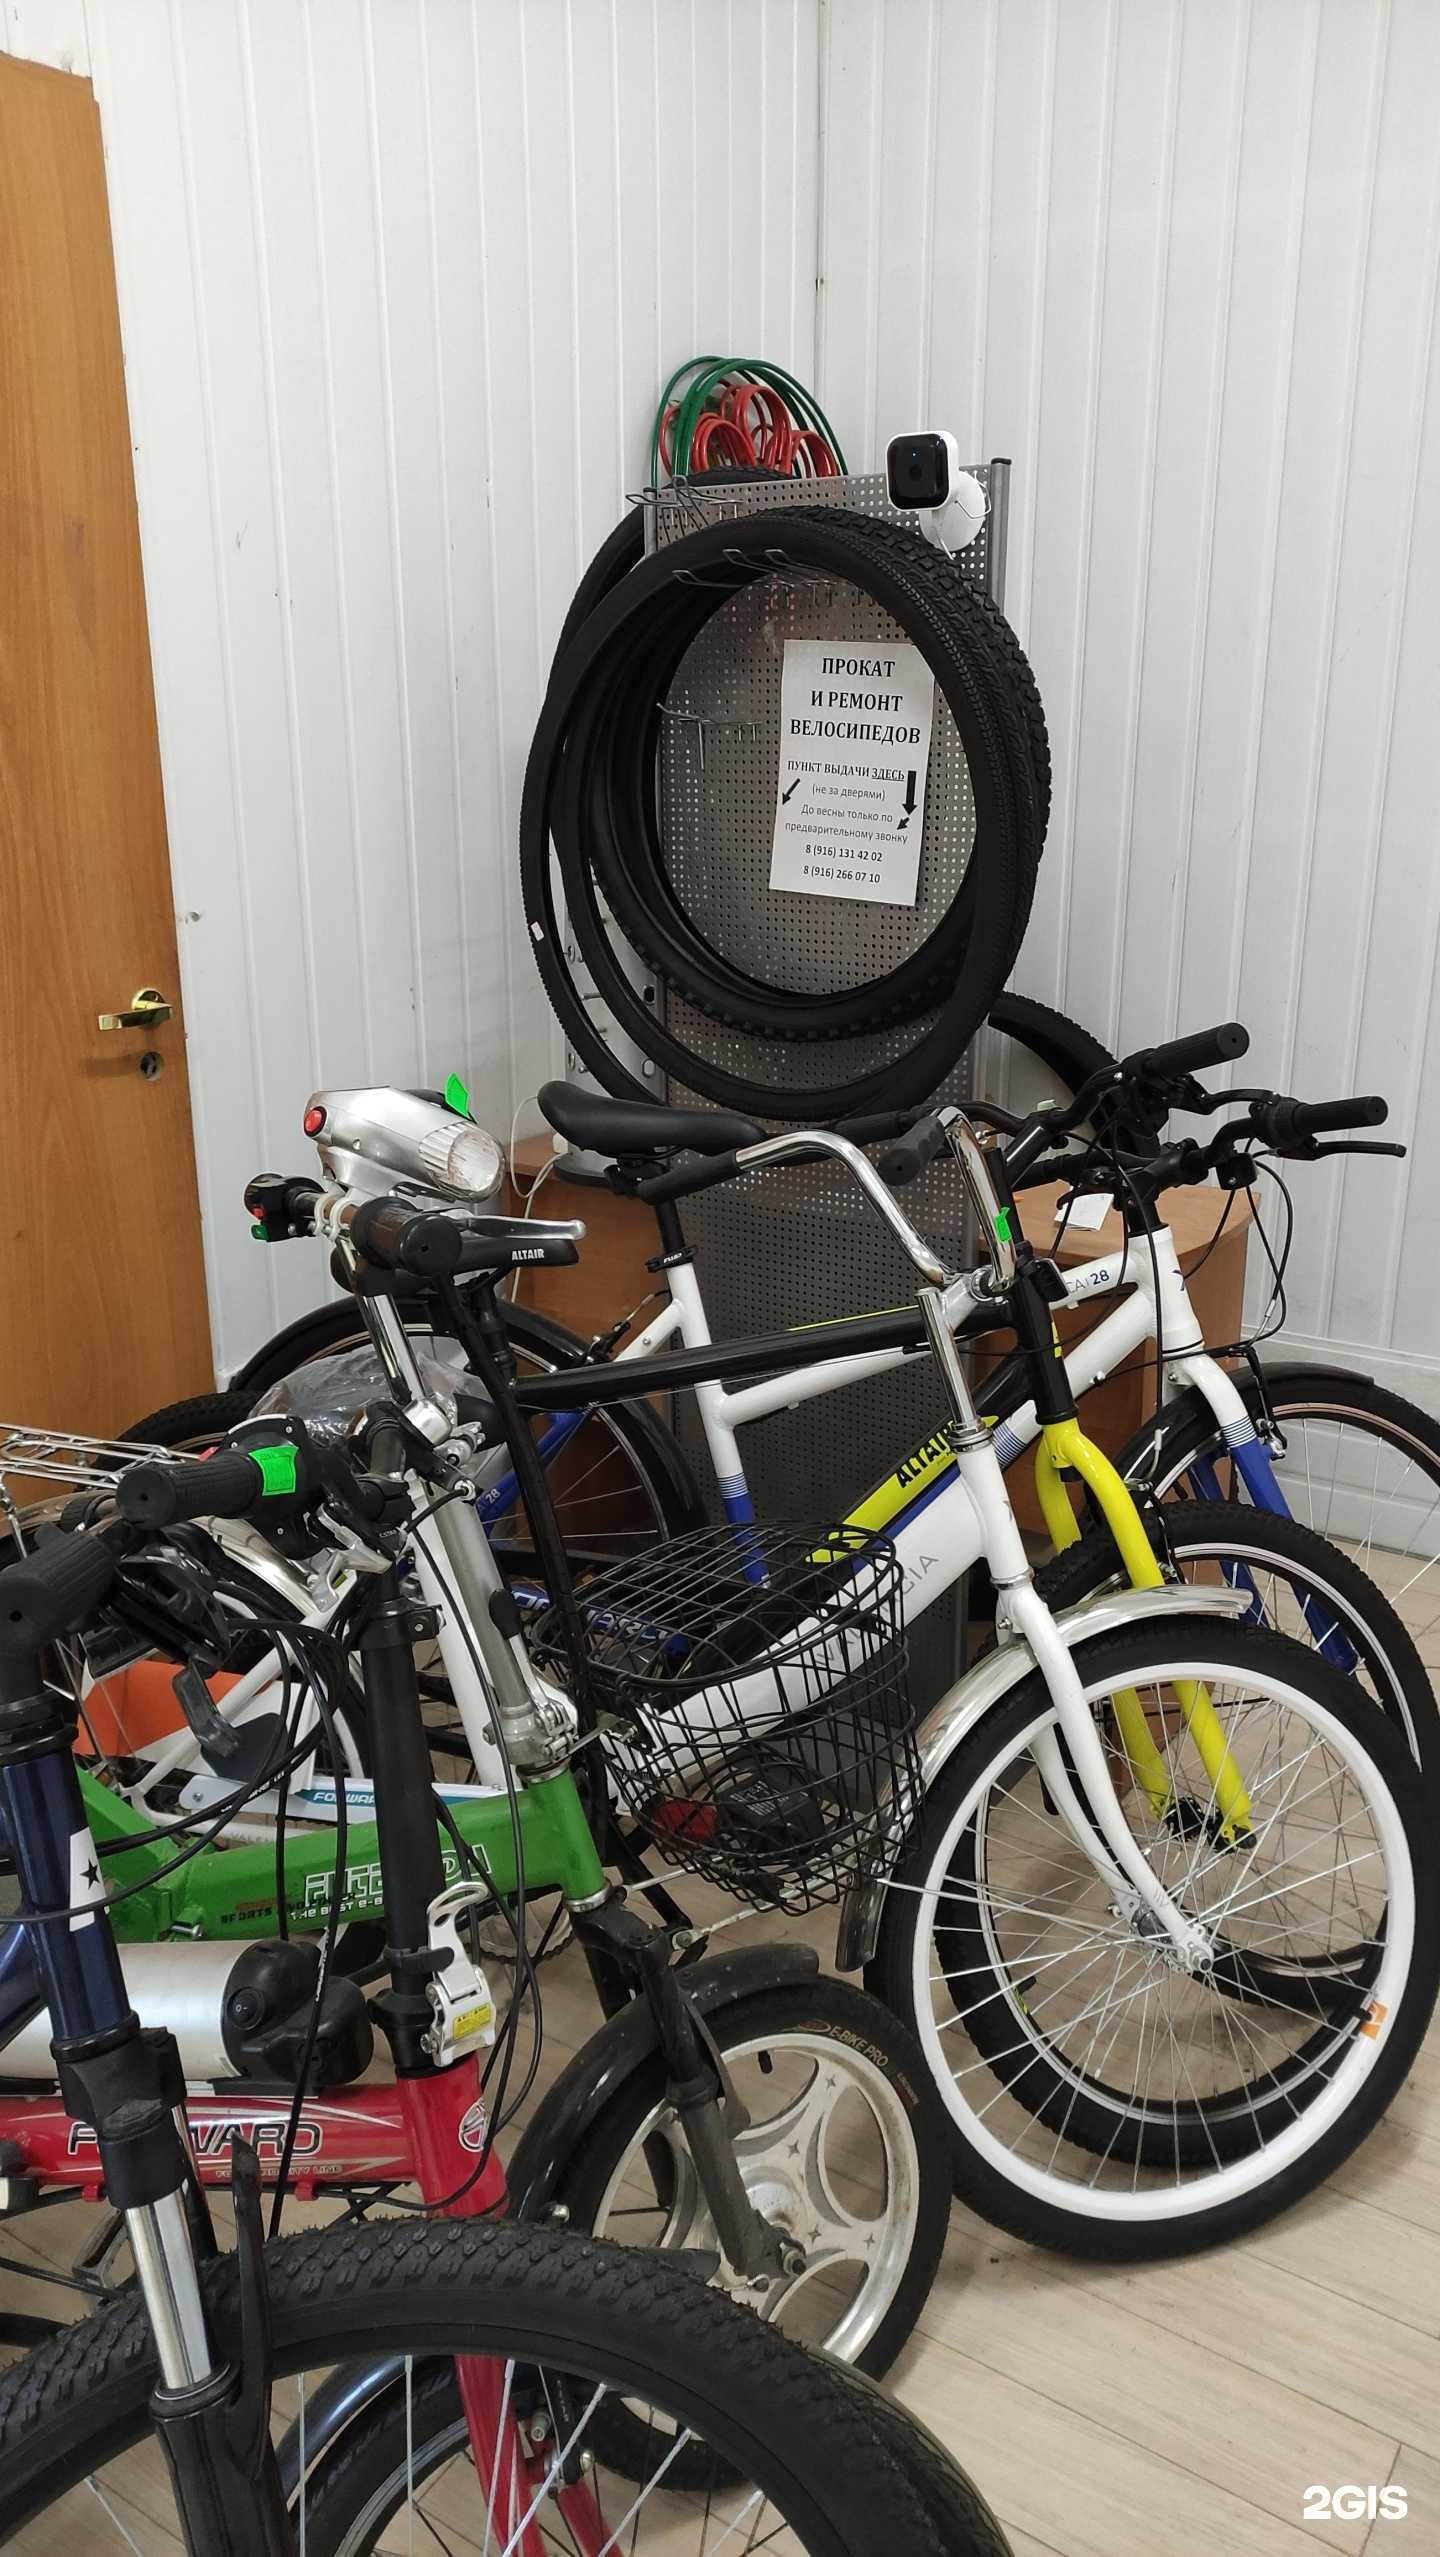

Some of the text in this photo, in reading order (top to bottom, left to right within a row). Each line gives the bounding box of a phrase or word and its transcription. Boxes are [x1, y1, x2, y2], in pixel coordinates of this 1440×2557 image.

[822, 657, 896, 678] ПРОКАТ
[811, 690, 903, 712] И РЕМОНТ
[790, 719, 921, 746] ВЕЛОСИПЕДОВ
[787, 760, 905, 781] ПУНКТ ВЫДАЧИ ЗДЕСЬ
[812, 783, 886, 801] (не за дверями)
[800, 804, 893, 823] До весны только по
[785, 822, 908, 844] предварительному звонку
[805, 844, 883, 862] 8 (916) 131 42 02
[803, 865, 880, 883] 8 (916) 266 07 10
[512, 1249, 544, 1261] ALTAIR
[1090, 1269, 1110, 1286] 28
[485, 1488, 500, 1504] 28
[829, 2026, 868, 2051] E-BIKE
[863, 2044, 889, 2067] PRO
